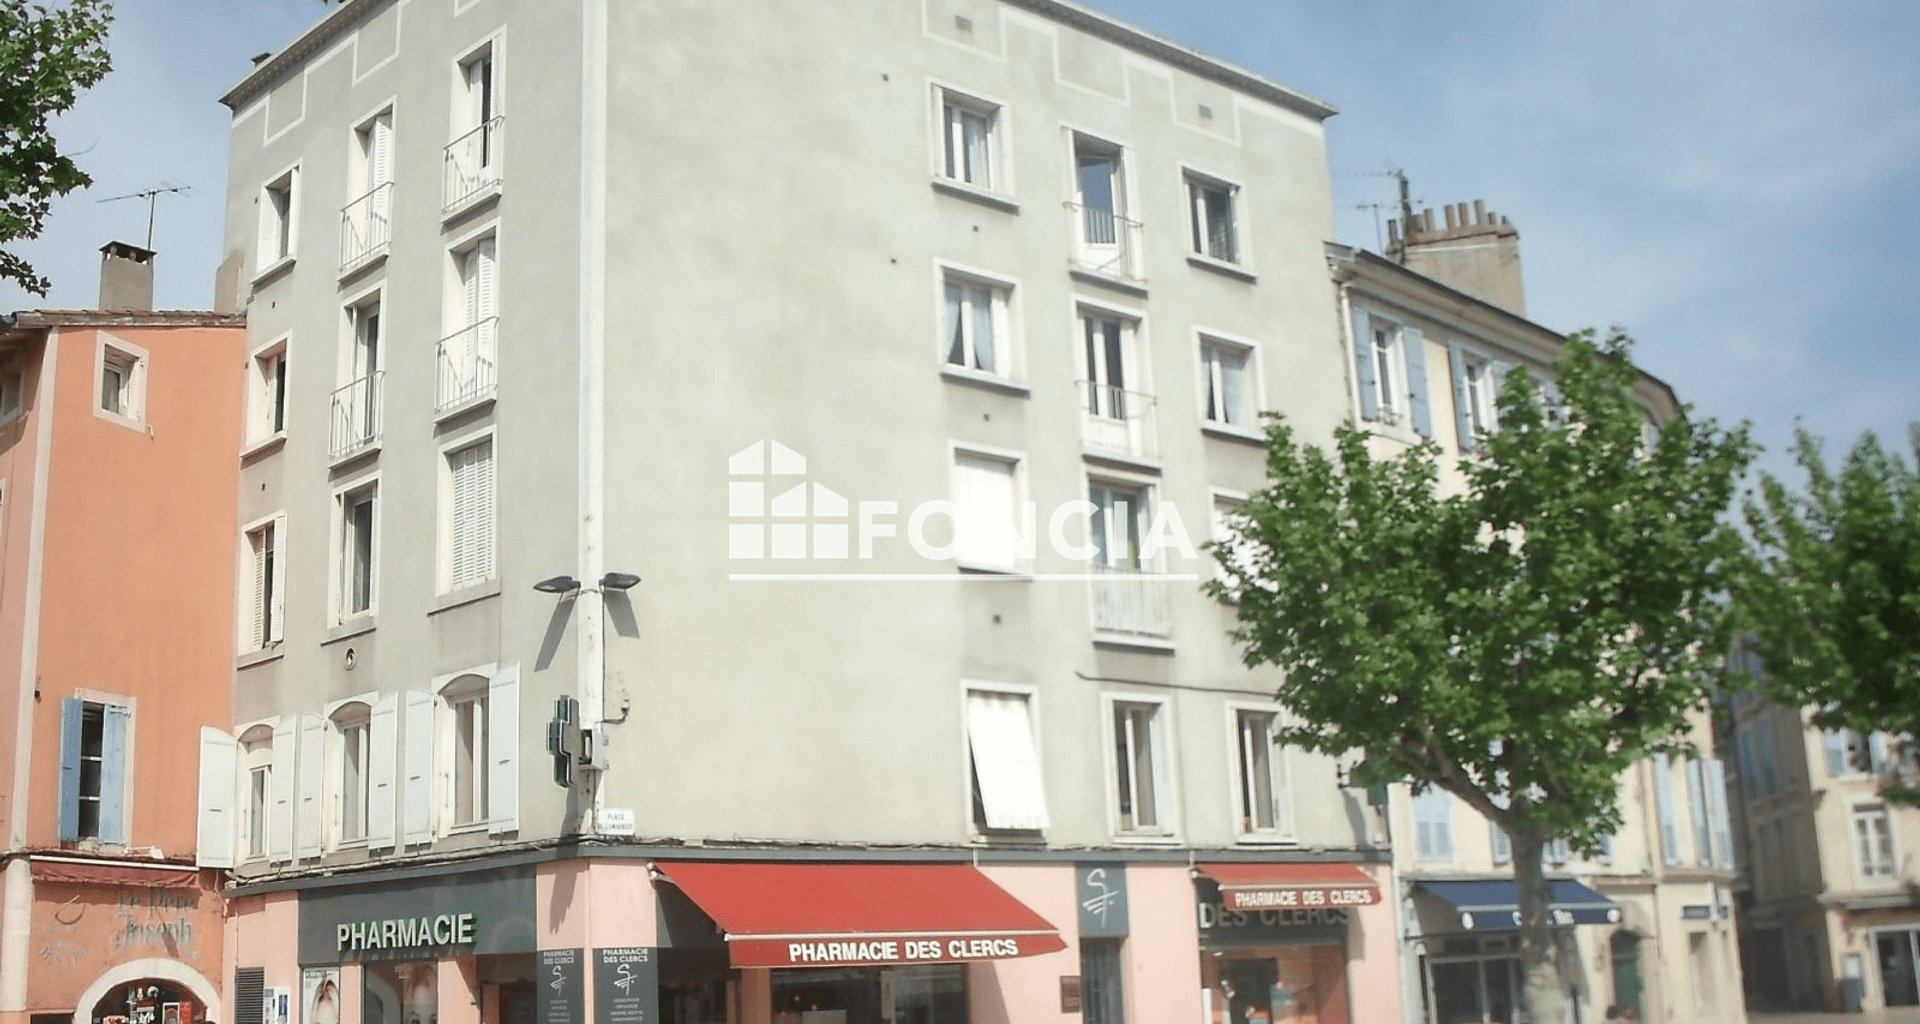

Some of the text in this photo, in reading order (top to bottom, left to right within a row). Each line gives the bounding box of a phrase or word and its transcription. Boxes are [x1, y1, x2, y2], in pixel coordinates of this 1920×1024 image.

[1234, 890, 1372, 906] PHARMACIE DES CLERCS
[1198, 903, 1249, 928] DES
[337, 913, 473, 952] PHARMACIE
[543, 949, 575, 957] PHARMACIE
[603, 948, 648, 956] PHARMACIE
[788, 939, 1019, 962] PHARMACIE DES CLERCS
[603, 955, 648, 964] DES CLERCS
